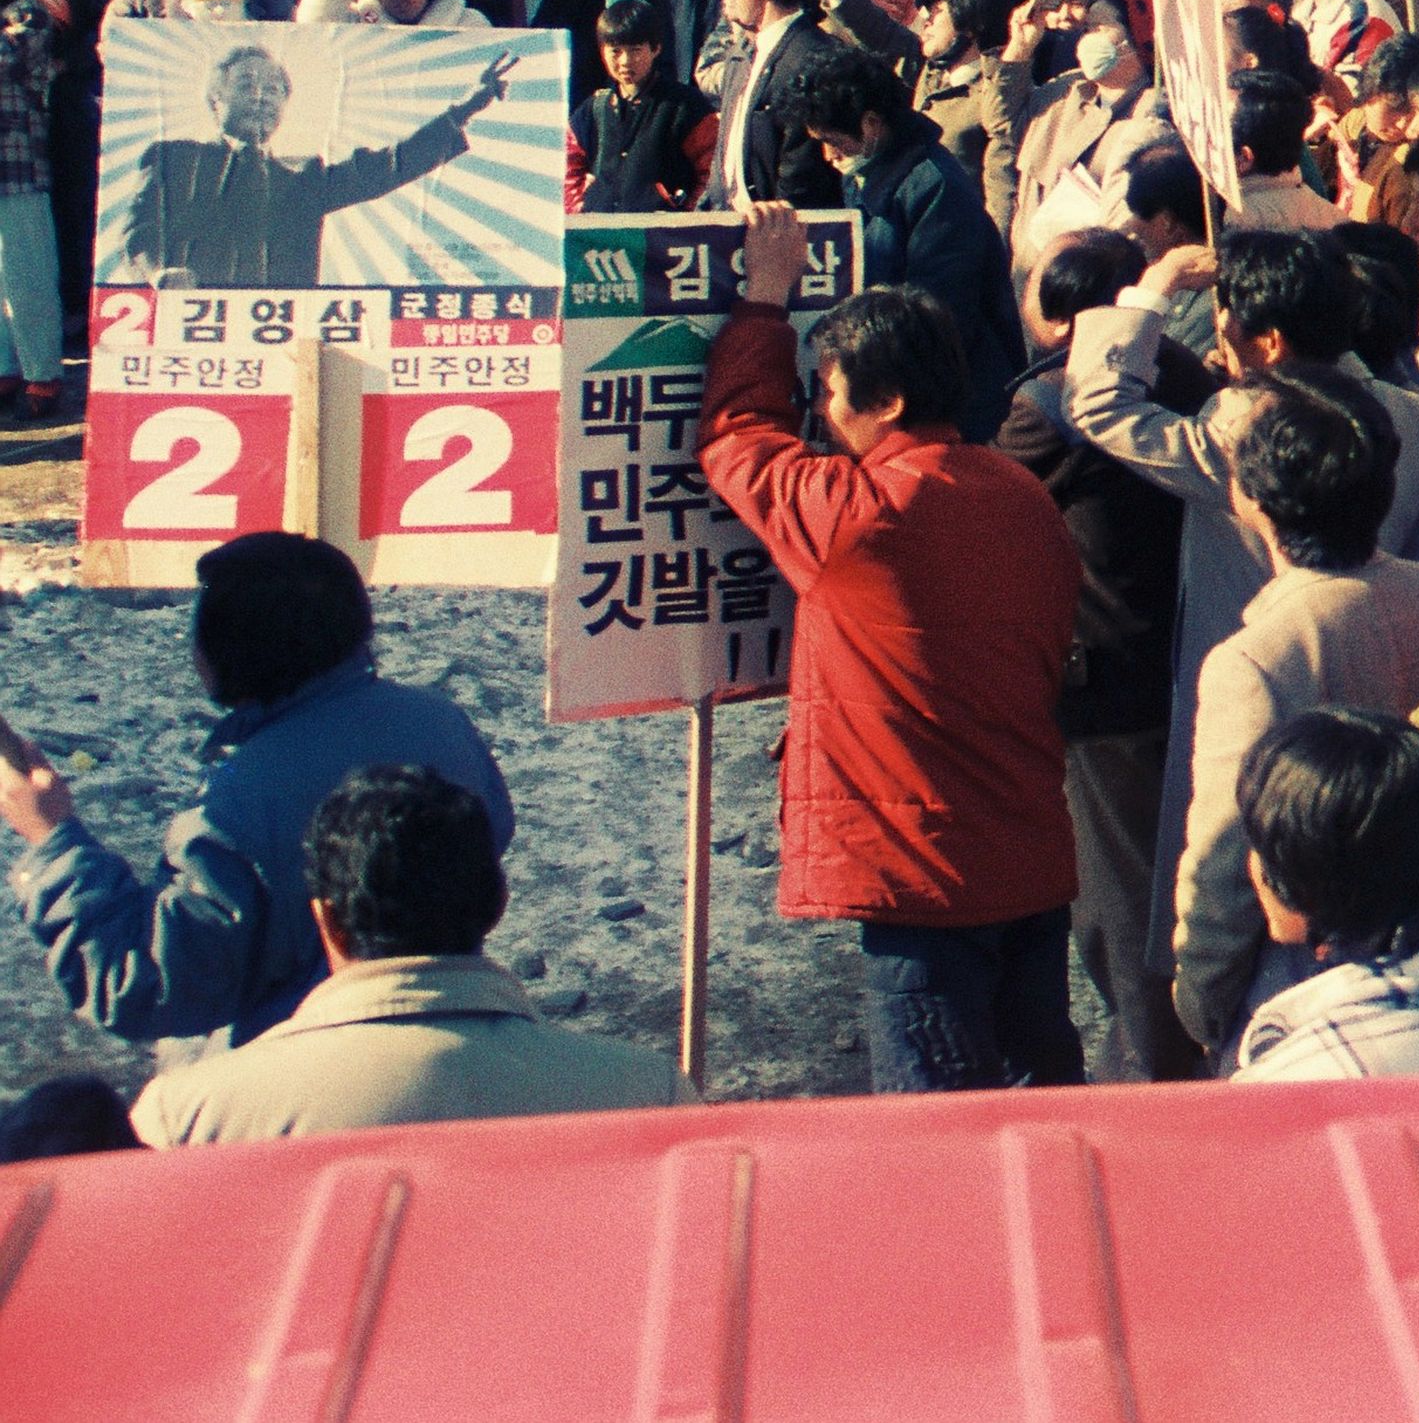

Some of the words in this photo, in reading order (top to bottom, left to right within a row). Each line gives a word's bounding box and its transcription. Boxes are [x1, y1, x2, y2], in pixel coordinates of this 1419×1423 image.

[665, 240, 841, 301] 김삼
[100, 292, 153, 346] 2
[182, 298, 367, 344] 김영삼
[401, 292, 533, 320] 군정종식
[121, 356, 265, 390] 민주안정
[391, 356, 530, 388] 민주안정
[122, 405, 243, 528] 2
[400, 405, 514, 527] 2
[580, 462, 739, 544] 민주
[577, 547, 780, 637] 깃발을
